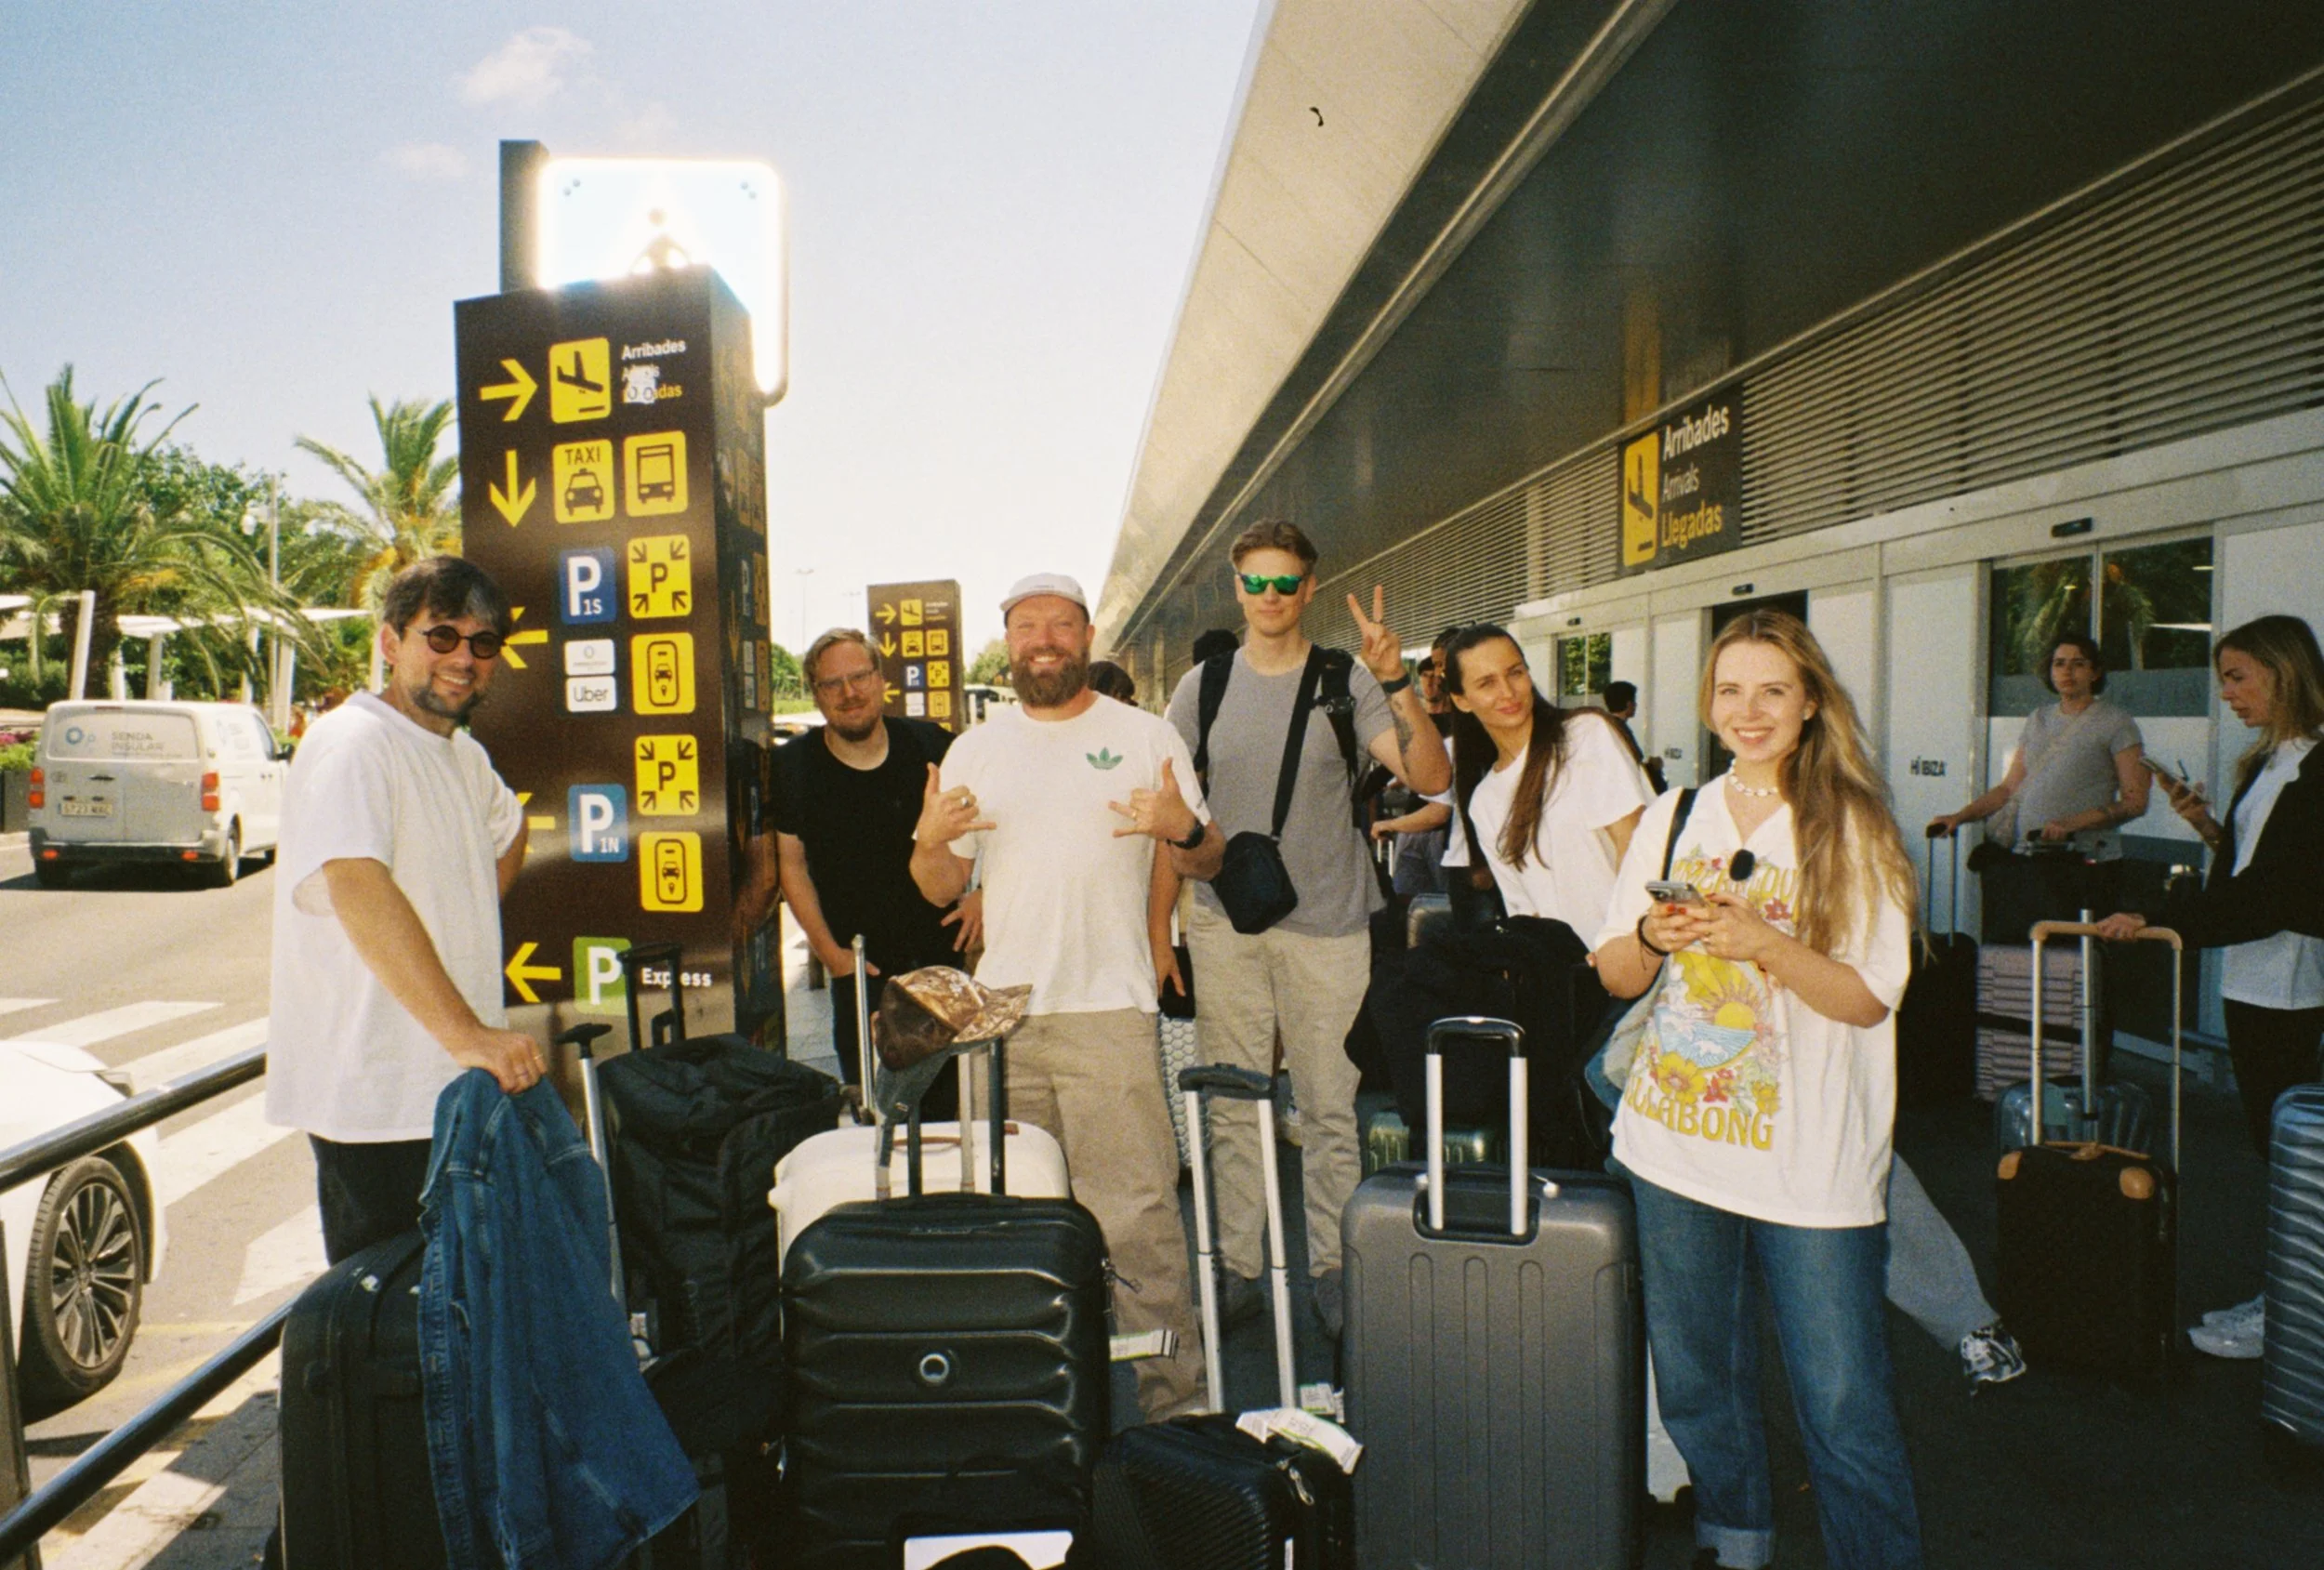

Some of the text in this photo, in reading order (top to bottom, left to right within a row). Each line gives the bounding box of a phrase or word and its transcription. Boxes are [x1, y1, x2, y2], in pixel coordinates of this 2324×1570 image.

[621, 338, 686, 360] Arribades
[1662, 403, 1730, 462] Arribades
[564, 446, 601, 465] TAXI
[1662, 462, 1700, 503] Arrivals
[1660, 499, 1723, 549] Llegadas
[568, 556, 601, 616] P
[651, 562, 667, 593] P
[573, 685, 609, 703] Uber
[657, 760, 675, 791] P
[580, 794, 614, 853] P
[588, 946, 712, 1006] P Expess
